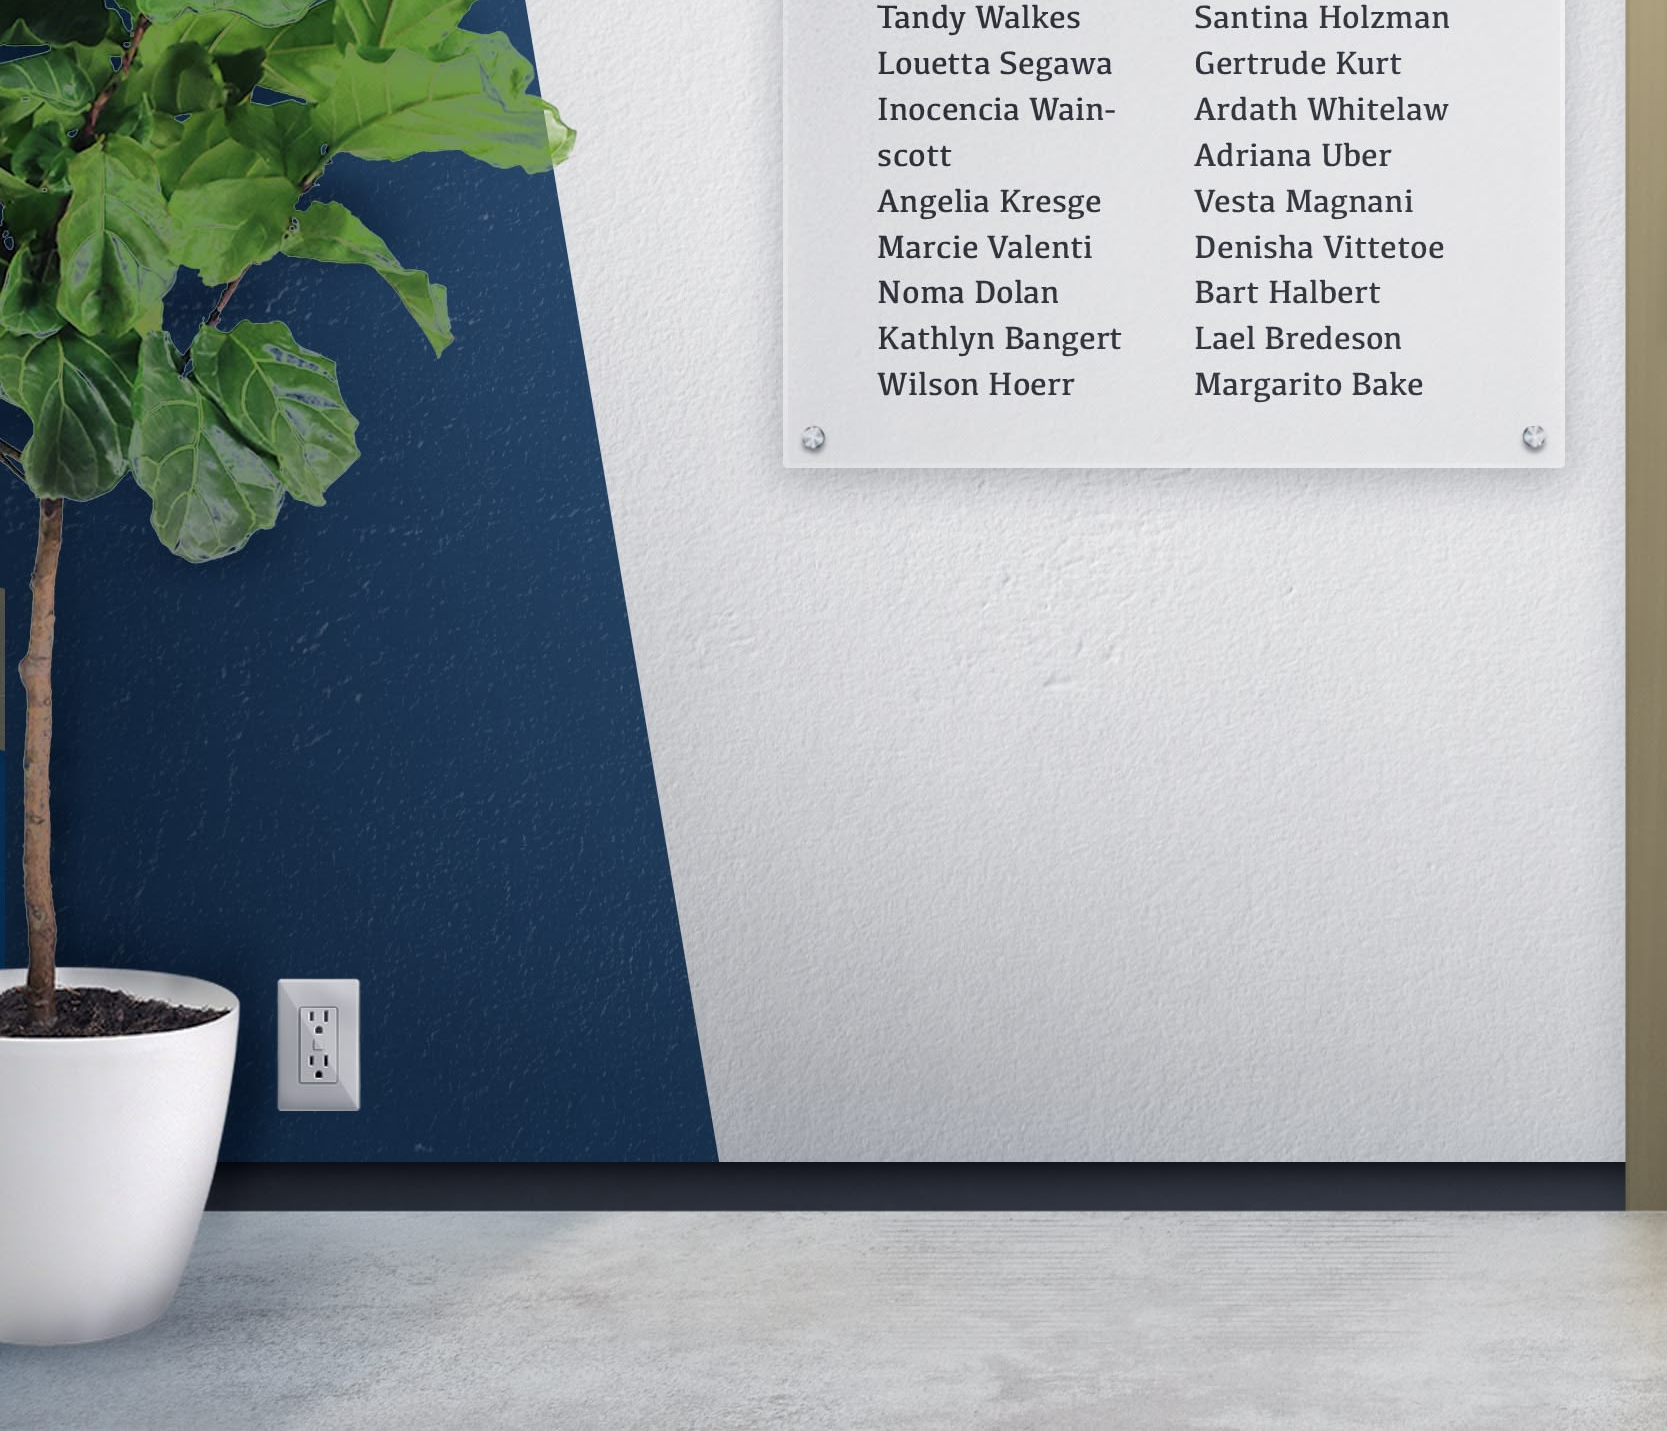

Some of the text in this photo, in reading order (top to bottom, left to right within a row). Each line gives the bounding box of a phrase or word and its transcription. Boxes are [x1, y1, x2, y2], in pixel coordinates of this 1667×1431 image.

[876, 3, 1081, 37] Tandy Walkes
[1195, 49, 1403, 76] Gertrude Kurt
[877, 96, 1116, 122] Inocencia Wain-
[1193, 141, 1393, 168] Adriana Uber
[876, 187, 1101, 221] Angelia Kresge
[1194, 233, 1444, 260] Denisha Vittetoe
[877, 278, 1059, 305] Noma Dolan
[1194, 324, 1402, 351] Lael Bredeson
[876, 370, 1076, 397] Wilson Hoerr
